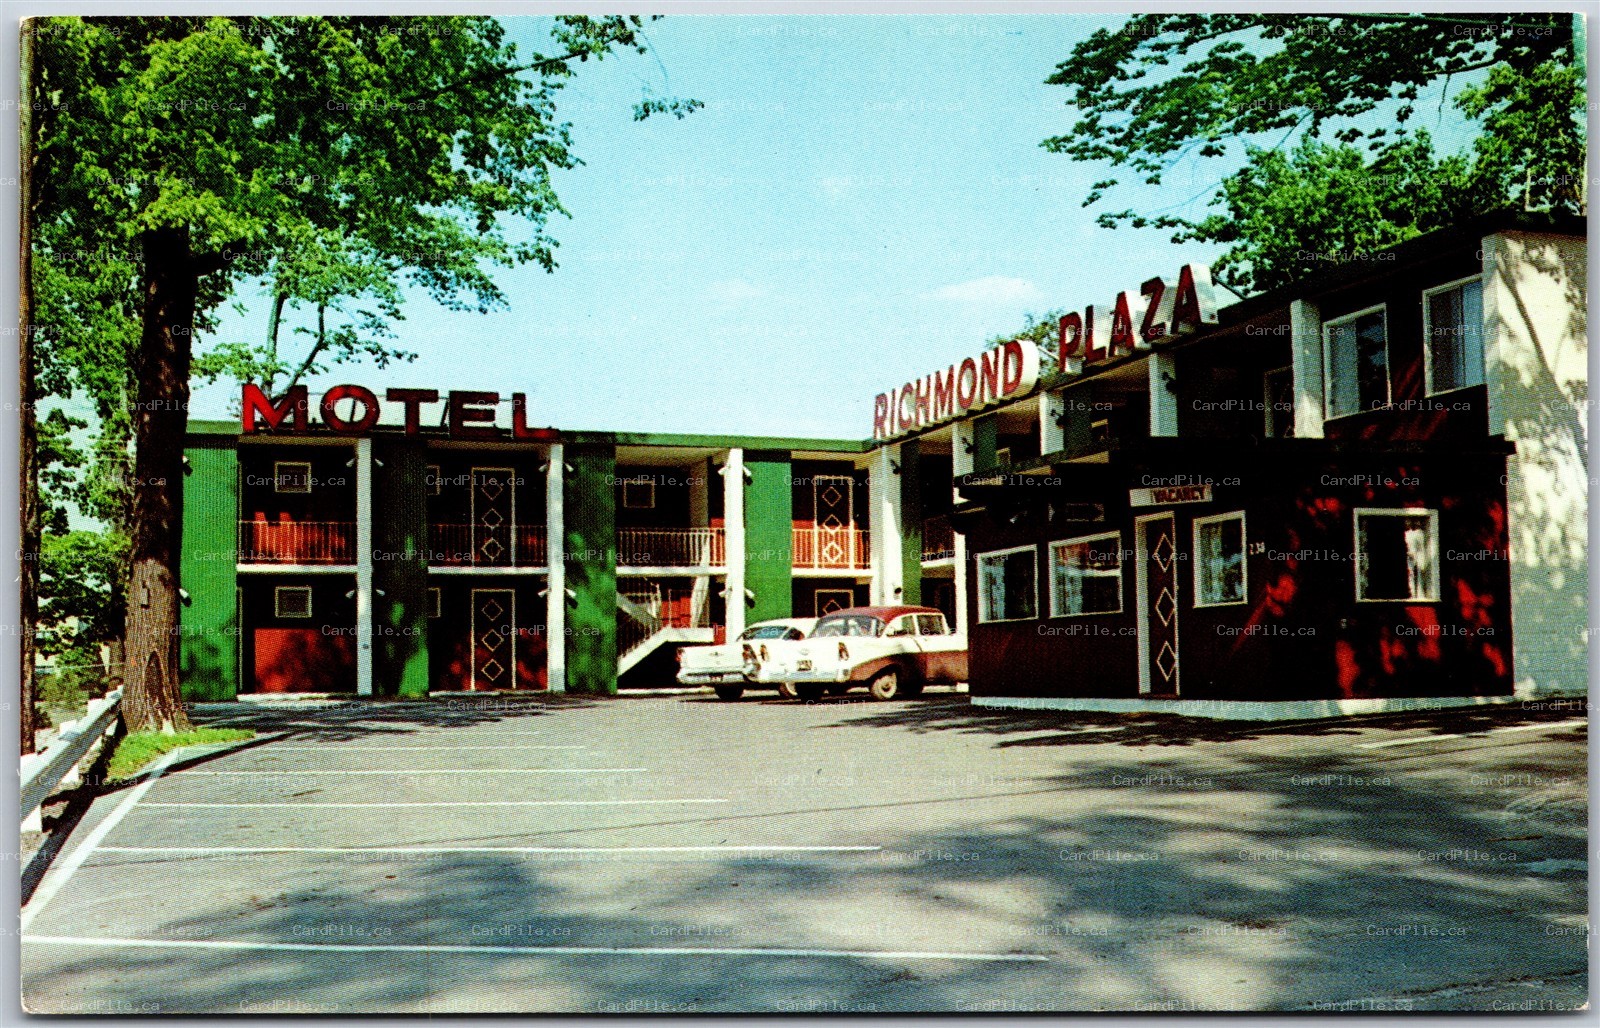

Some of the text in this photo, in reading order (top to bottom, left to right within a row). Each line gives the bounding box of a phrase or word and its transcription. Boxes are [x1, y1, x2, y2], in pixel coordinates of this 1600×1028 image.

[873, 263, 1207, 439] RICHMOND PLAZA
[242, 383, 560, 439] MOTEL
